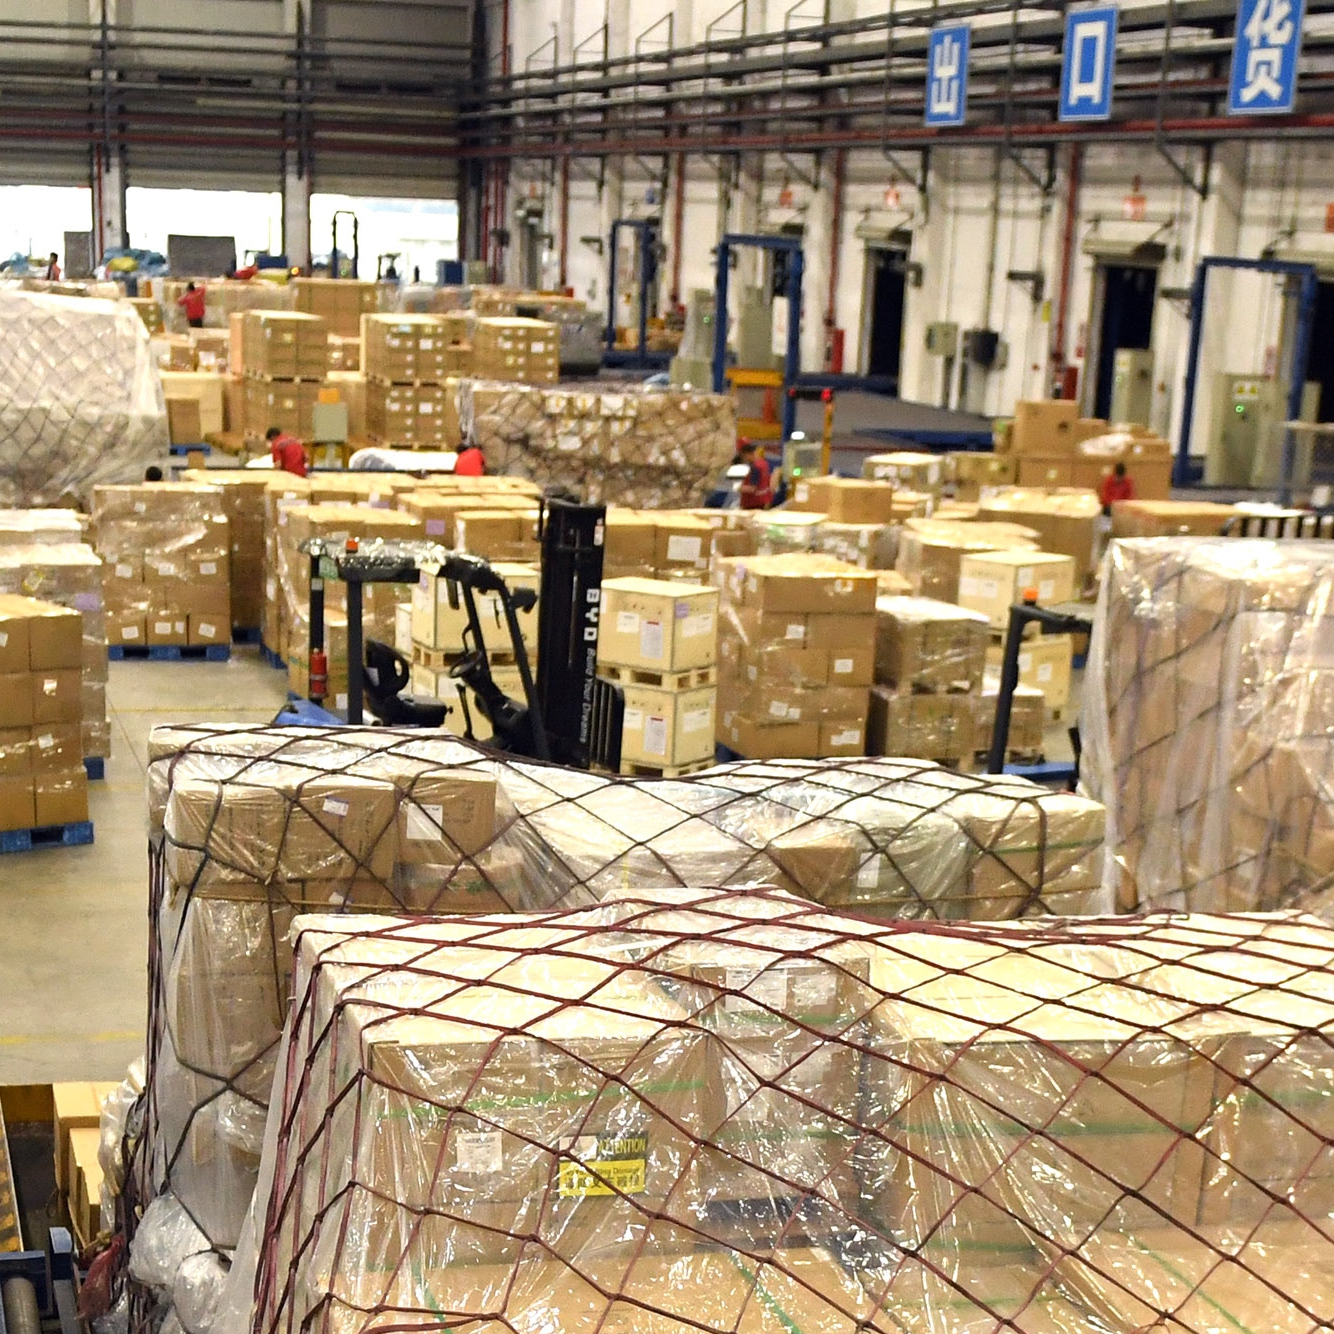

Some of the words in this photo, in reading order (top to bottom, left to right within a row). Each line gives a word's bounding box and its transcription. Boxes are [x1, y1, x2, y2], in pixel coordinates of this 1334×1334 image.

[931, 34, 960, 115] 出
[1068, 21, 1108, 105] 口
[583, 589, 600, 641] BYD
[598, 1138, 646, 1154] ATTENTION
